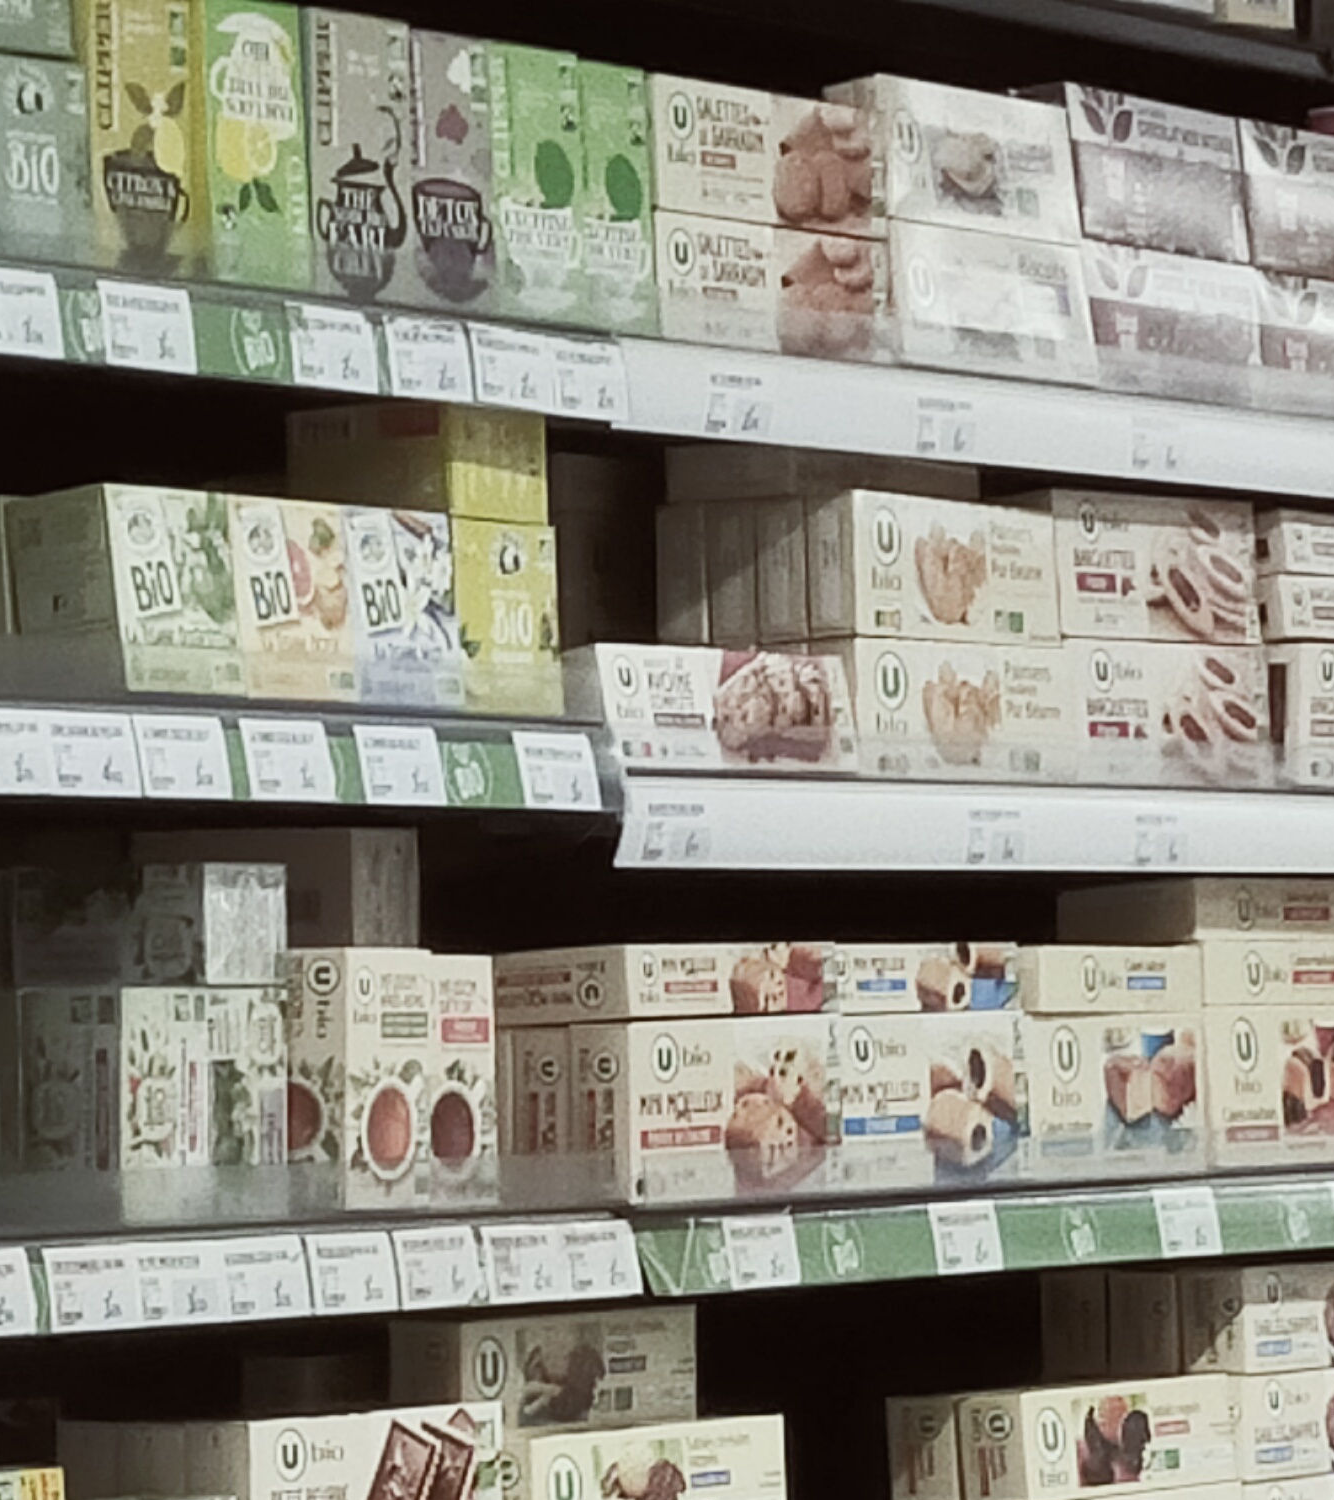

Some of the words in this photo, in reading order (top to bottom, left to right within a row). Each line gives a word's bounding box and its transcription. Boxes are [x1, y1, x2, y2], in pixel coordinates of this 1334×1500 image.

[131, 560, 174, 612] BiO
[251, 571, 294, 621] BiO
[362, 578, 401, 627] BiO
[492, 601, 534, 648] BiO
[311, 1439, 344, 1463] bio
